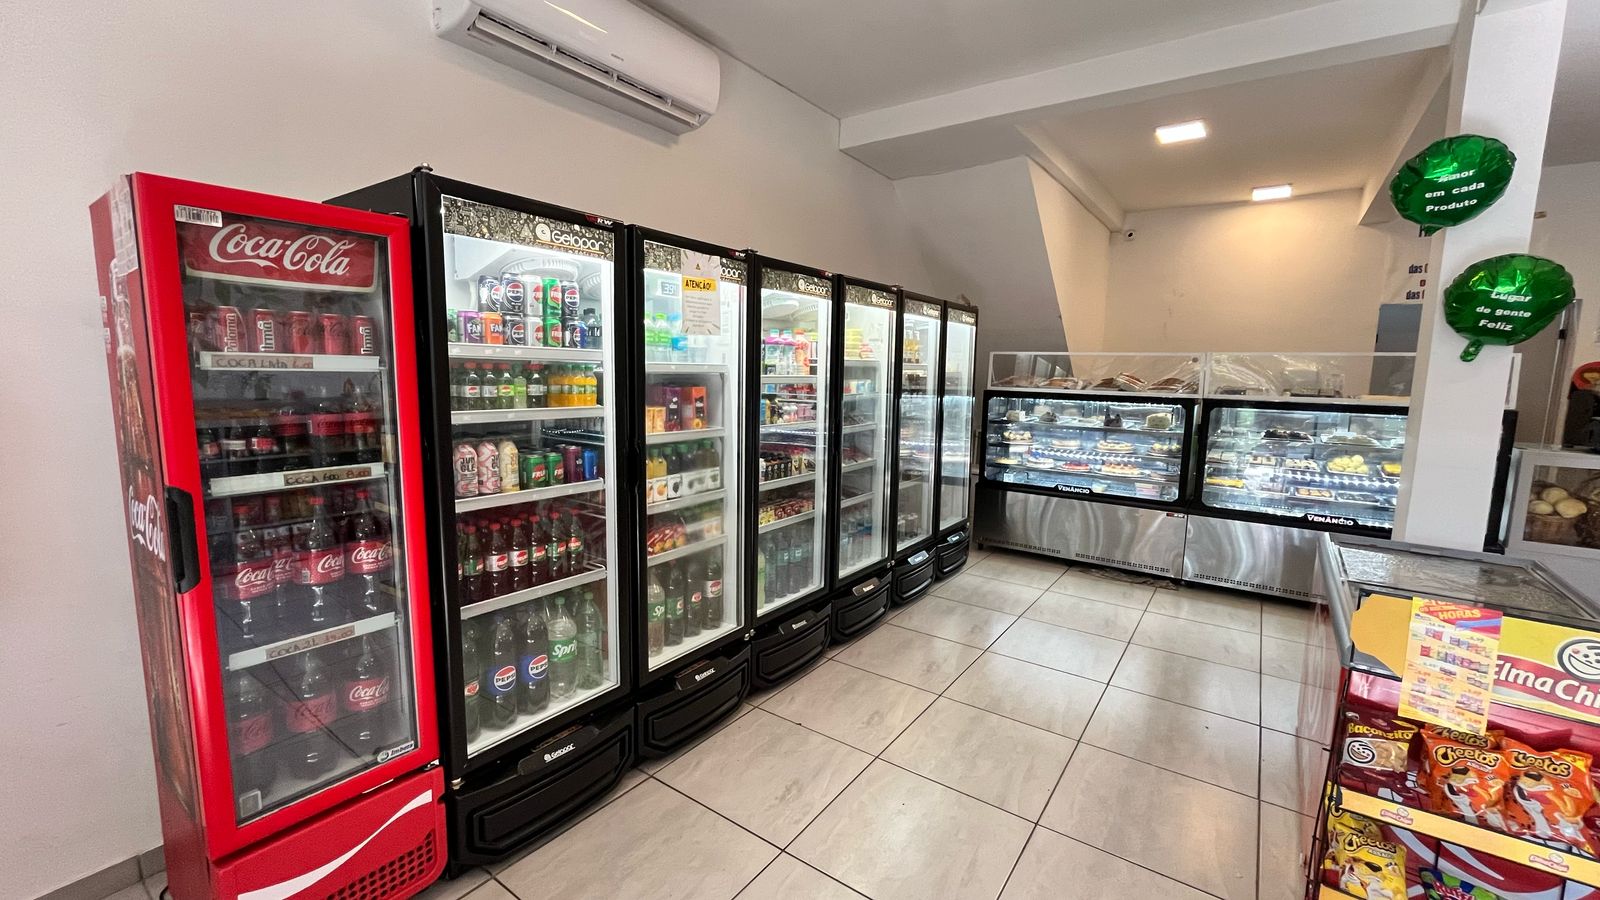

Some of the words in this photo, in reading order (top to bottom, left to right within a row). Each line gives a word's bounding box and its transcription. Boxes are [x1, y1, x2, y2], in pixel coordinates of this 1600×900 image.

[1425, 190, 1445, 199] em
[1452, 182, 1485, 194] cada
[1425, 199, 1478, 212] Produto
[551, 230, 604, 251] Gelopar
[208, 223, 358, 277] Coca-Cola
[1409, 263, 1423, 274] das
[805, 282, 828, 295] Gelopar
[1406, 290, 1421, 300] das
[1491, 290, 1533, 302] Lugar
[1475, 306, 1492, 314] de
[1495, 309, 1532, 318] gente
[467, 323, 482, 334] FAN
[490, 324, 503, 333] FAN
[1478, 319, 1514, 331] Feliz
[1307, 514, 1354, 526] VENÂNCIO
[653, 606, 664, 617] Sp
[1439, 609, 1481, 619] HORAS
[530, 663, 548, 671] PEPS
[1434, 747, 1499, 768] Cheetos
[1344, 834, 1397, 853] Cheetos
